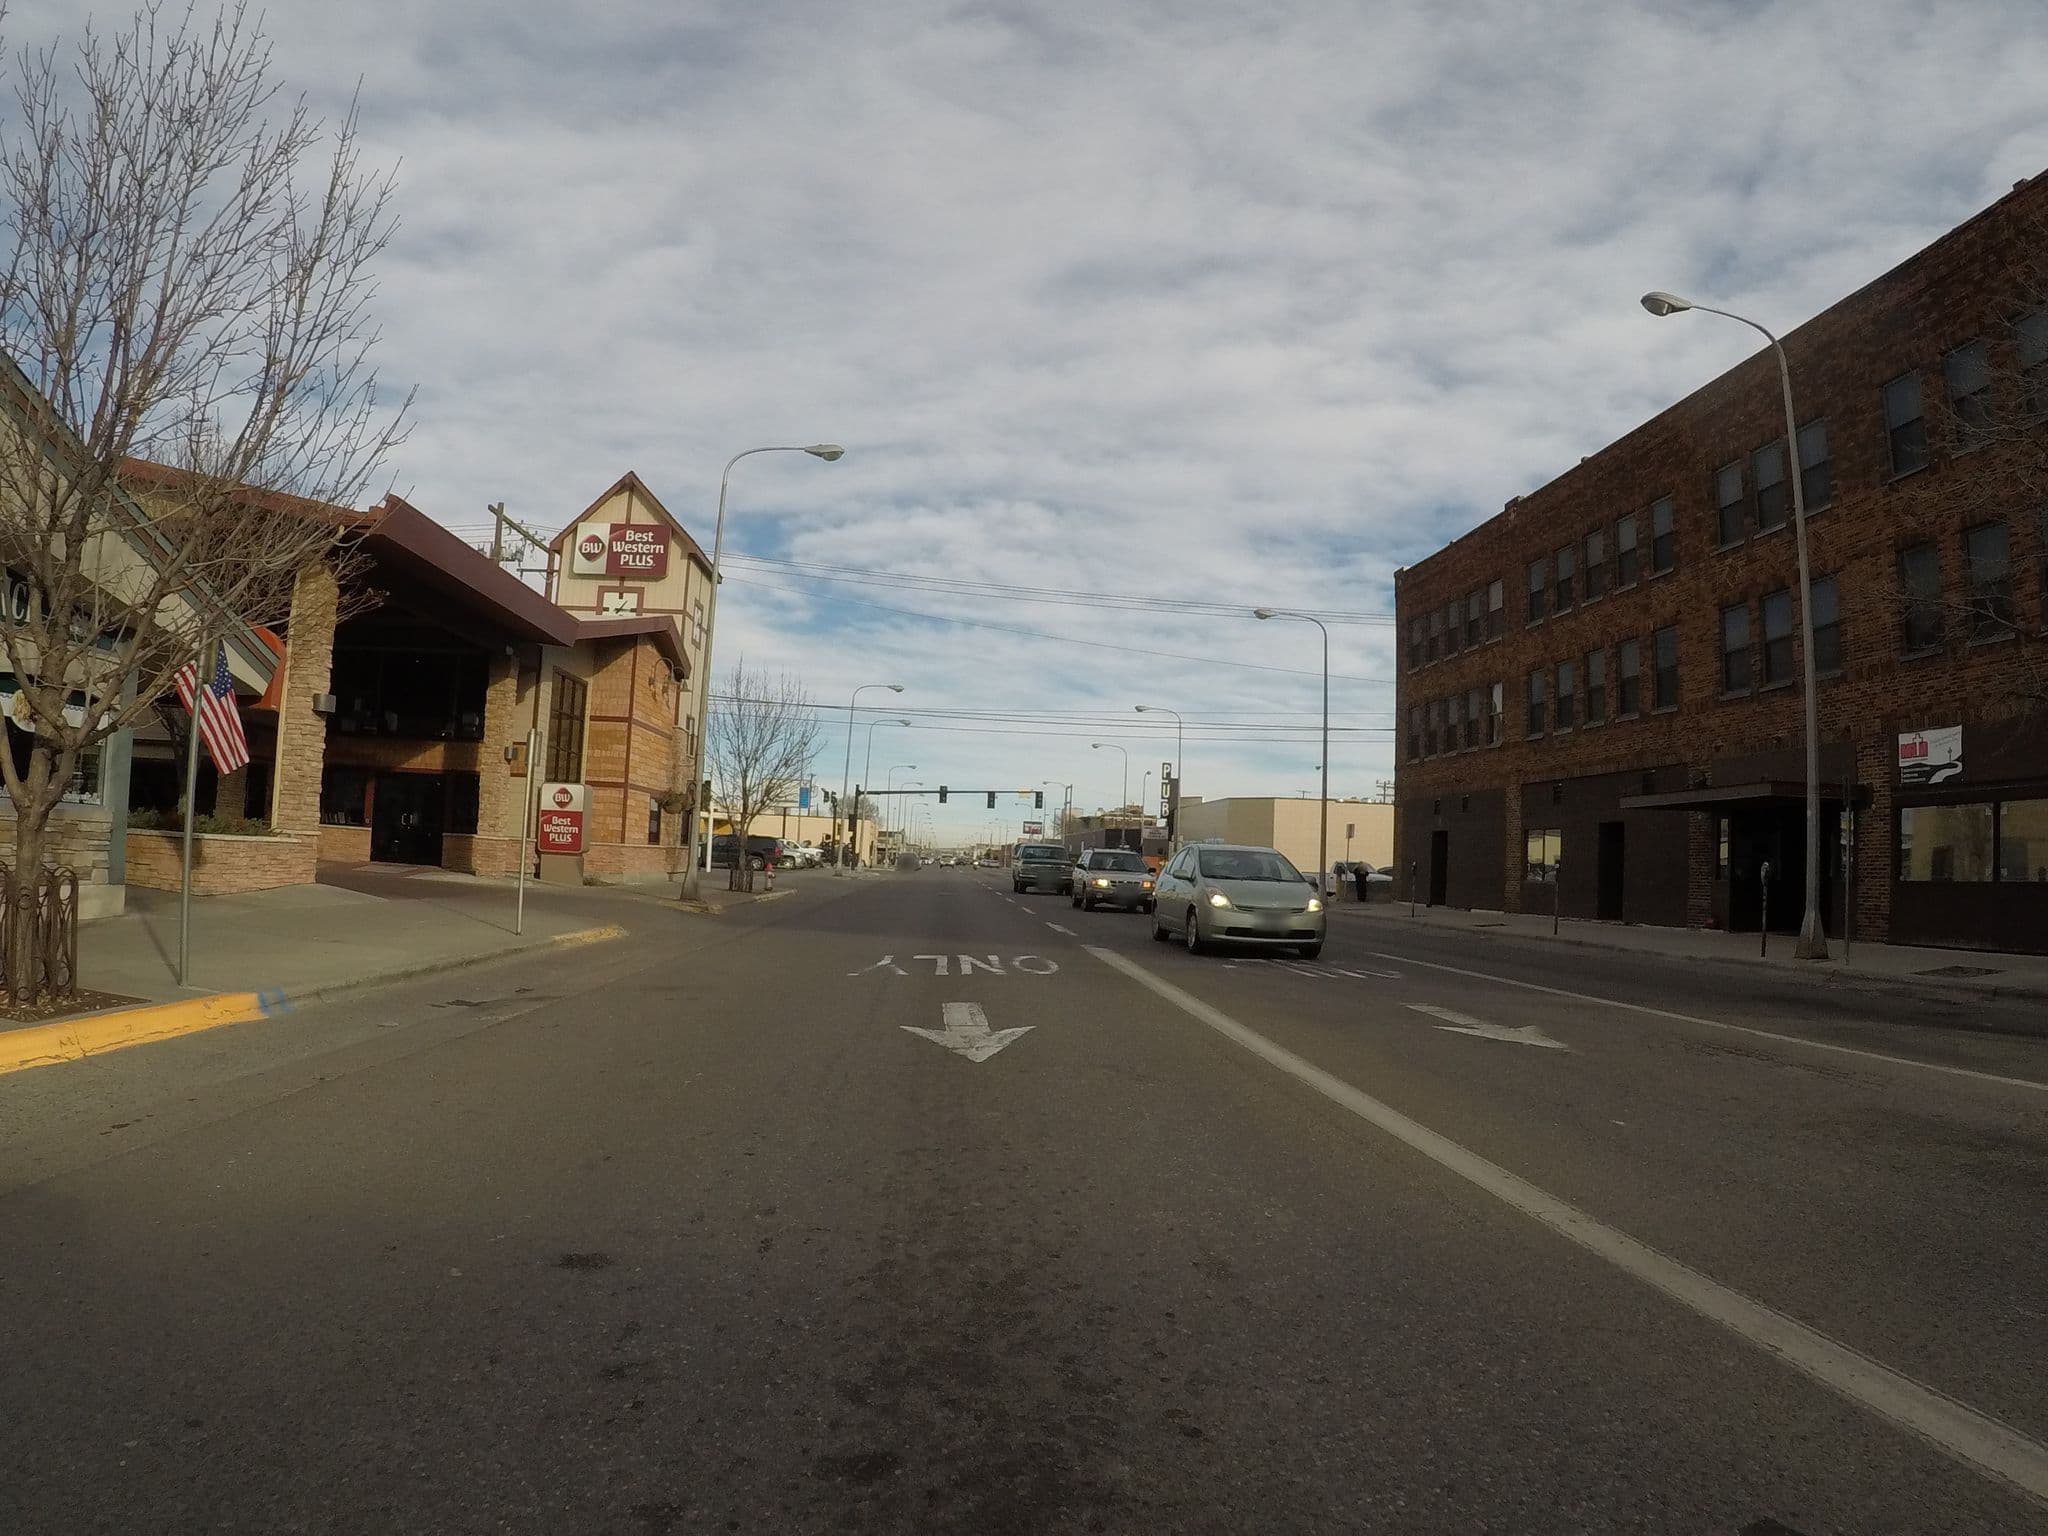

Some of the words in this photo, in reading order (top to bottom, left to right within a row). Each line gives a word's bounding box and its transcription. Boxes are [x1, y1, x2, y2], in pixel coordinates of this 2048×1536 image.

[626, 530, 654, 542] Best
[582, 542, 602, 554] BW
[612, 541, 665, 554] Western
[620, 554, 654, 566] PLUS
[1162, 764, 1170, 816] PUB
[554, 793, 570, 802] BW
[552, 816, 571, 825] Best
[543, 823, 579, 834] Western
[549, 833, 572, 842] PLUS
[847, 955, 1059, 975] ONLY
